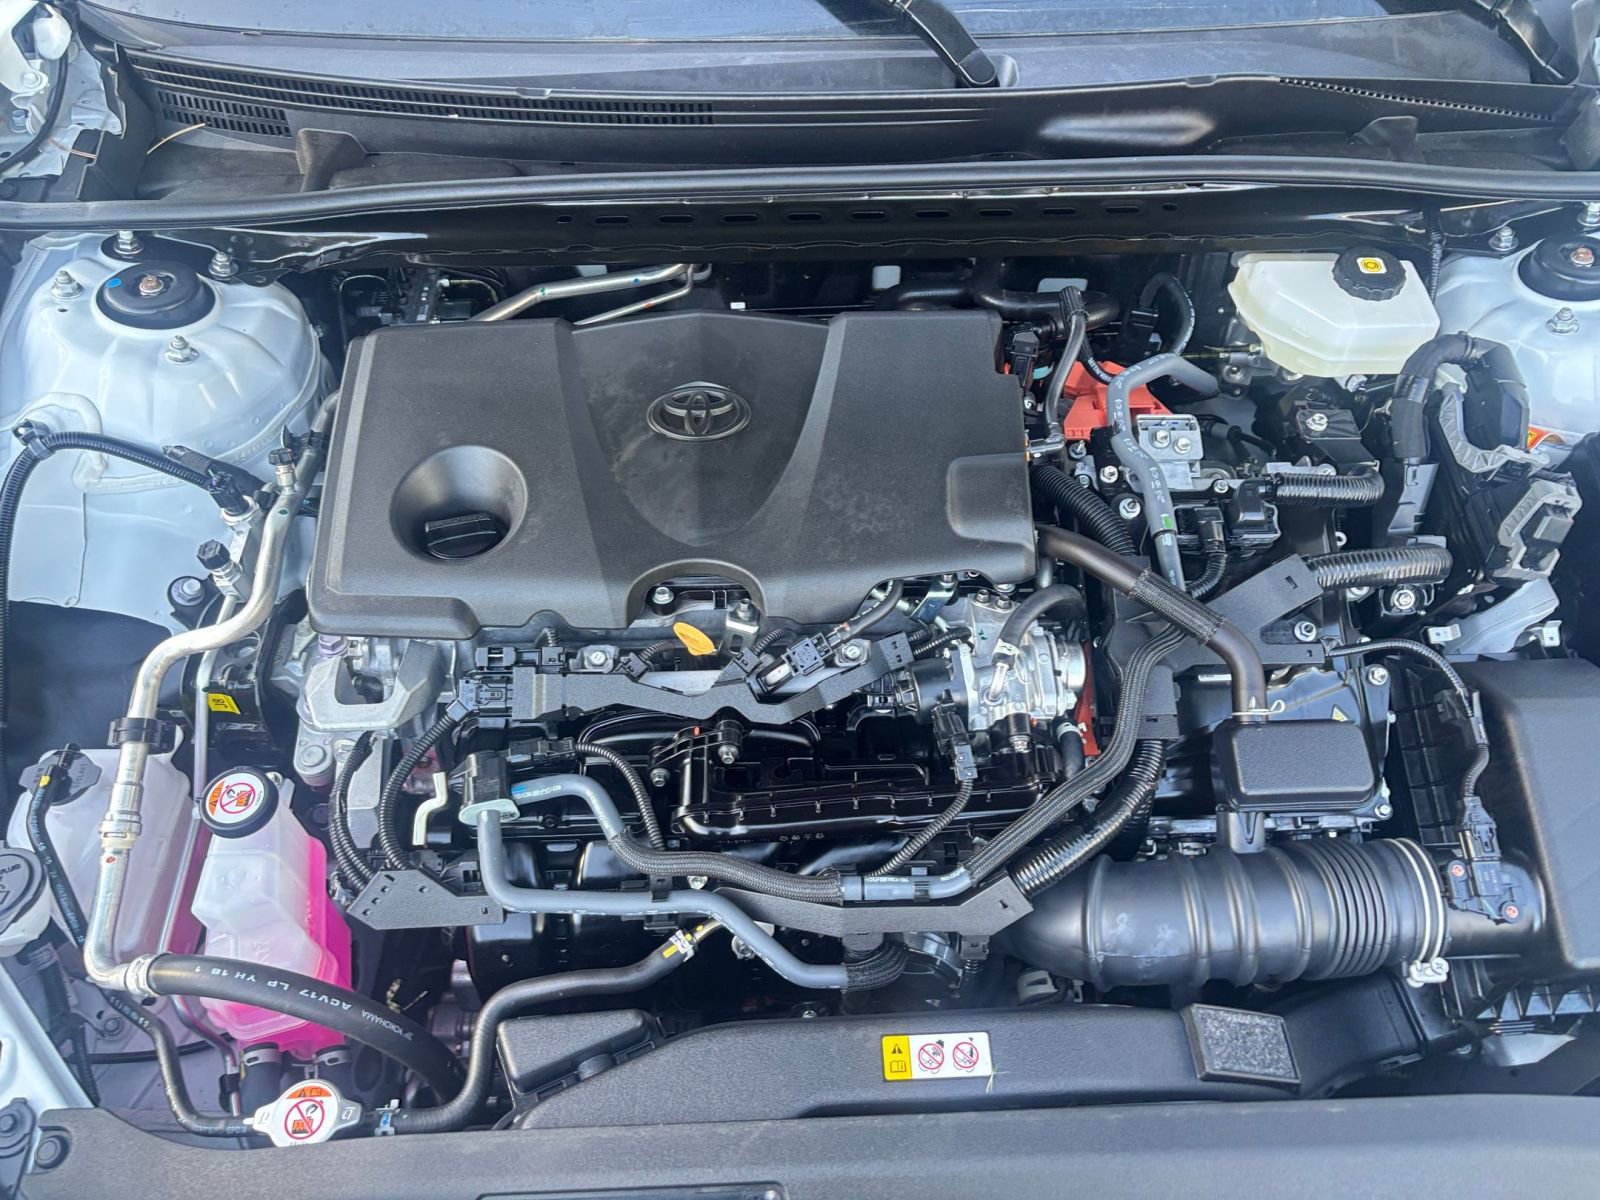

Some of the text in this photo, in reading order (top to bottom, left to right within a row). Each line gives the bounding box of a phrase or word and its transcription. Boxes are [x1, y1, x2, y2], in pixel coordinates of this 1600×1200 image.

[234, 971, 257, 983] YH
[266, 980, 290, 991] LP
[299, 989, 352, 1011] ACV17
[362, 1009, 403, 1036] YOKOHAMA
